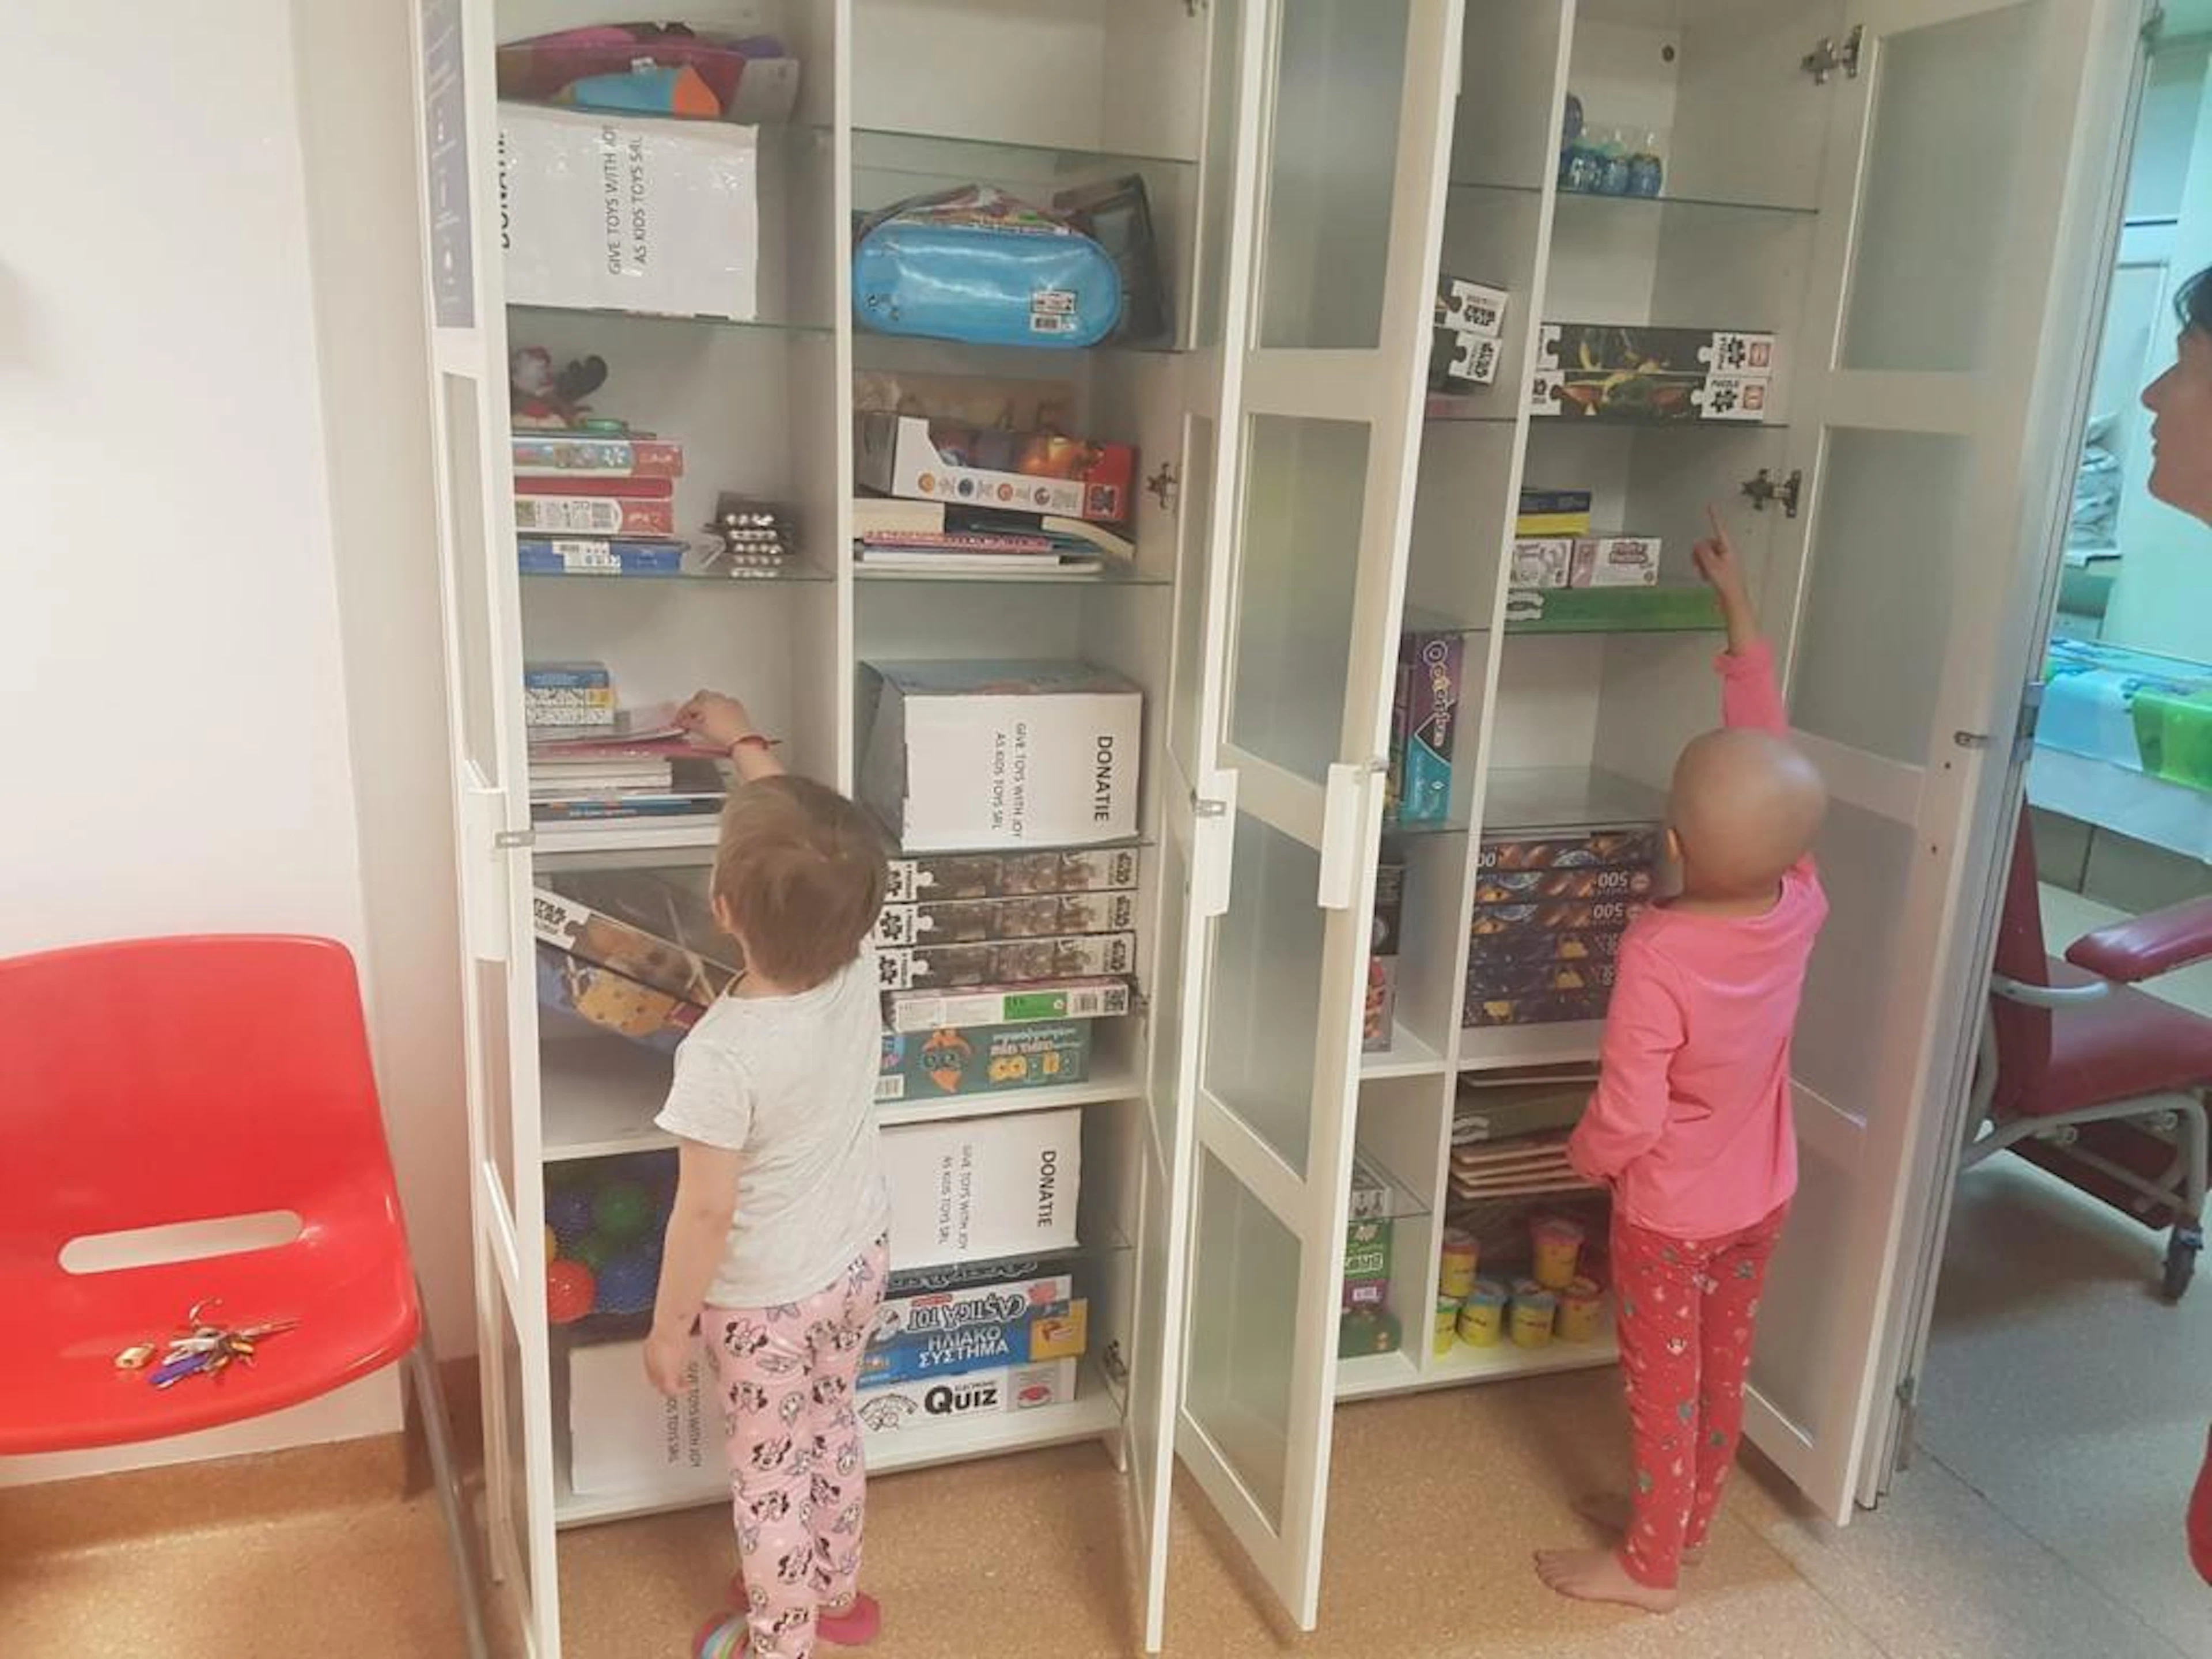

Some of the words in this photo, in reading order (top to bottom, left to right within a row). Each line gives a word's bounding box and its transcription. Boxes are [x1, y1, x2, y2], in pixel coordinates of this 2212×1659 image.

[604, 153, 619, 194] WITH
[630, 166, 645, 202] TOYS
[605, 199, 620, 234] TOYS
[632, 207, 646, 241] KIDS
[607, 241, 621, 275] GIVE
[633, 245, 646, 263] AS
[1094, 736, 1113, 822] DONATIE
[1597, 870, 1630, 887] 500
[1593, 902, 1624, 919] 500
[1037, 1149, 1057, 1229] DONATIE
[917, 1338, 1010, 1369] ΣΥΣΤΗΜΑ
